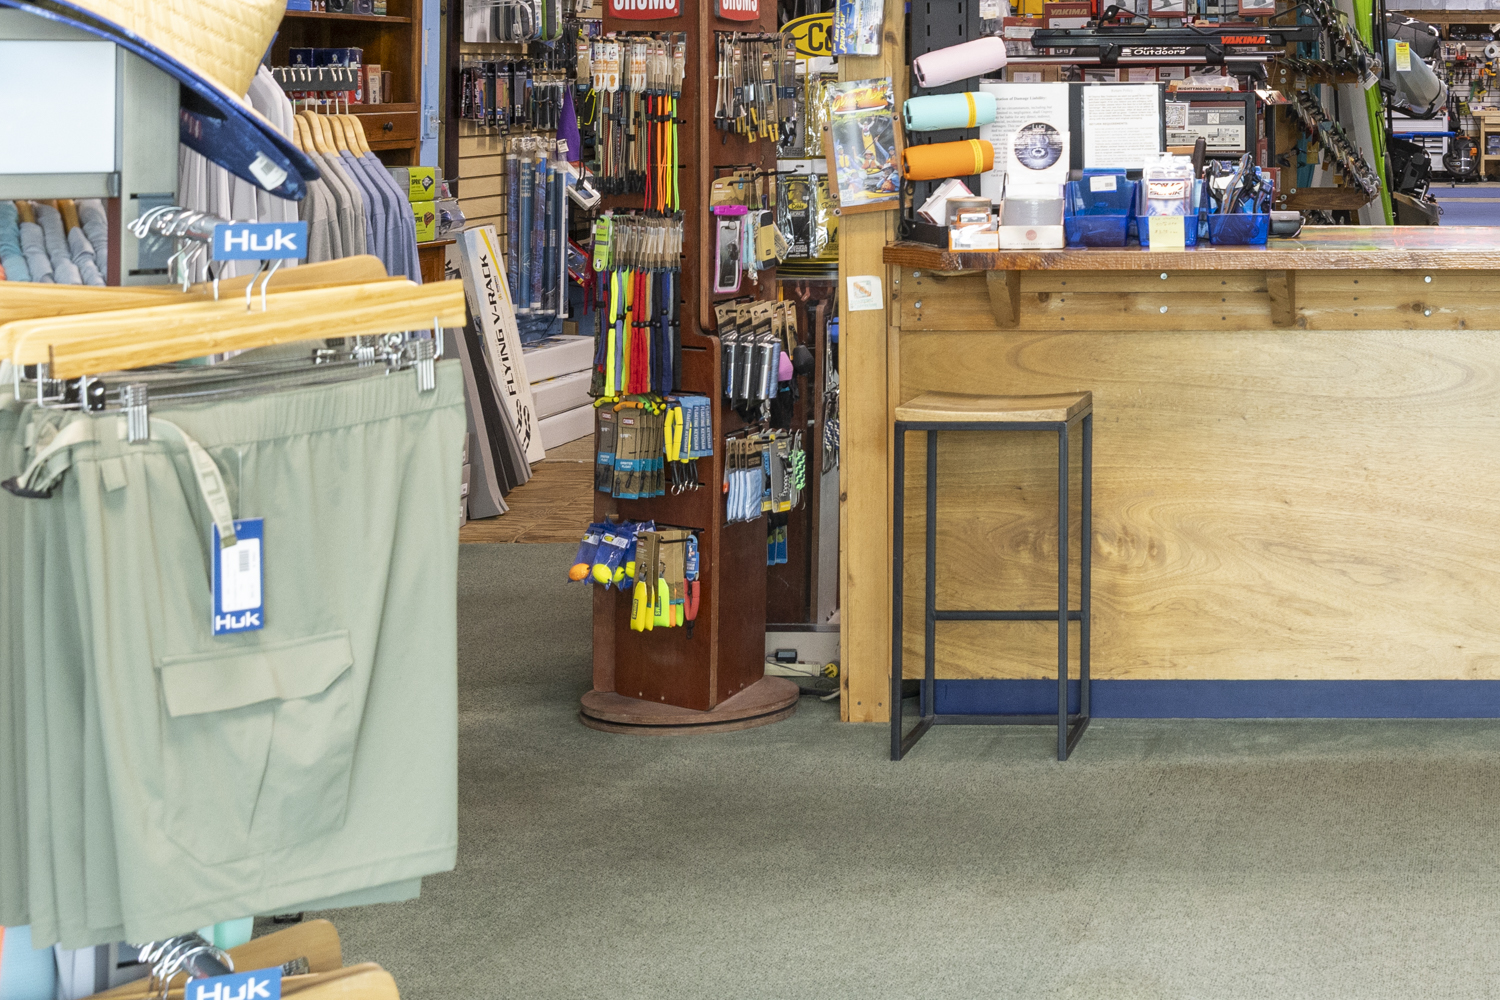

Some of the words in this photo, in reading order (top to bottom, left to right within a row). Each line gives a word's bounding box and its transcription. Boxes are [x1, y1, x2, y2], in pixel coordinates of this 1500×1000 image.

[1050, 8, 1089, 16] YAKIMA
[1220, 36, 1266, 44] YAKIMA
[480, 254, 504, 326] V-RACK
[494, 327, 517, 397] FLYING
